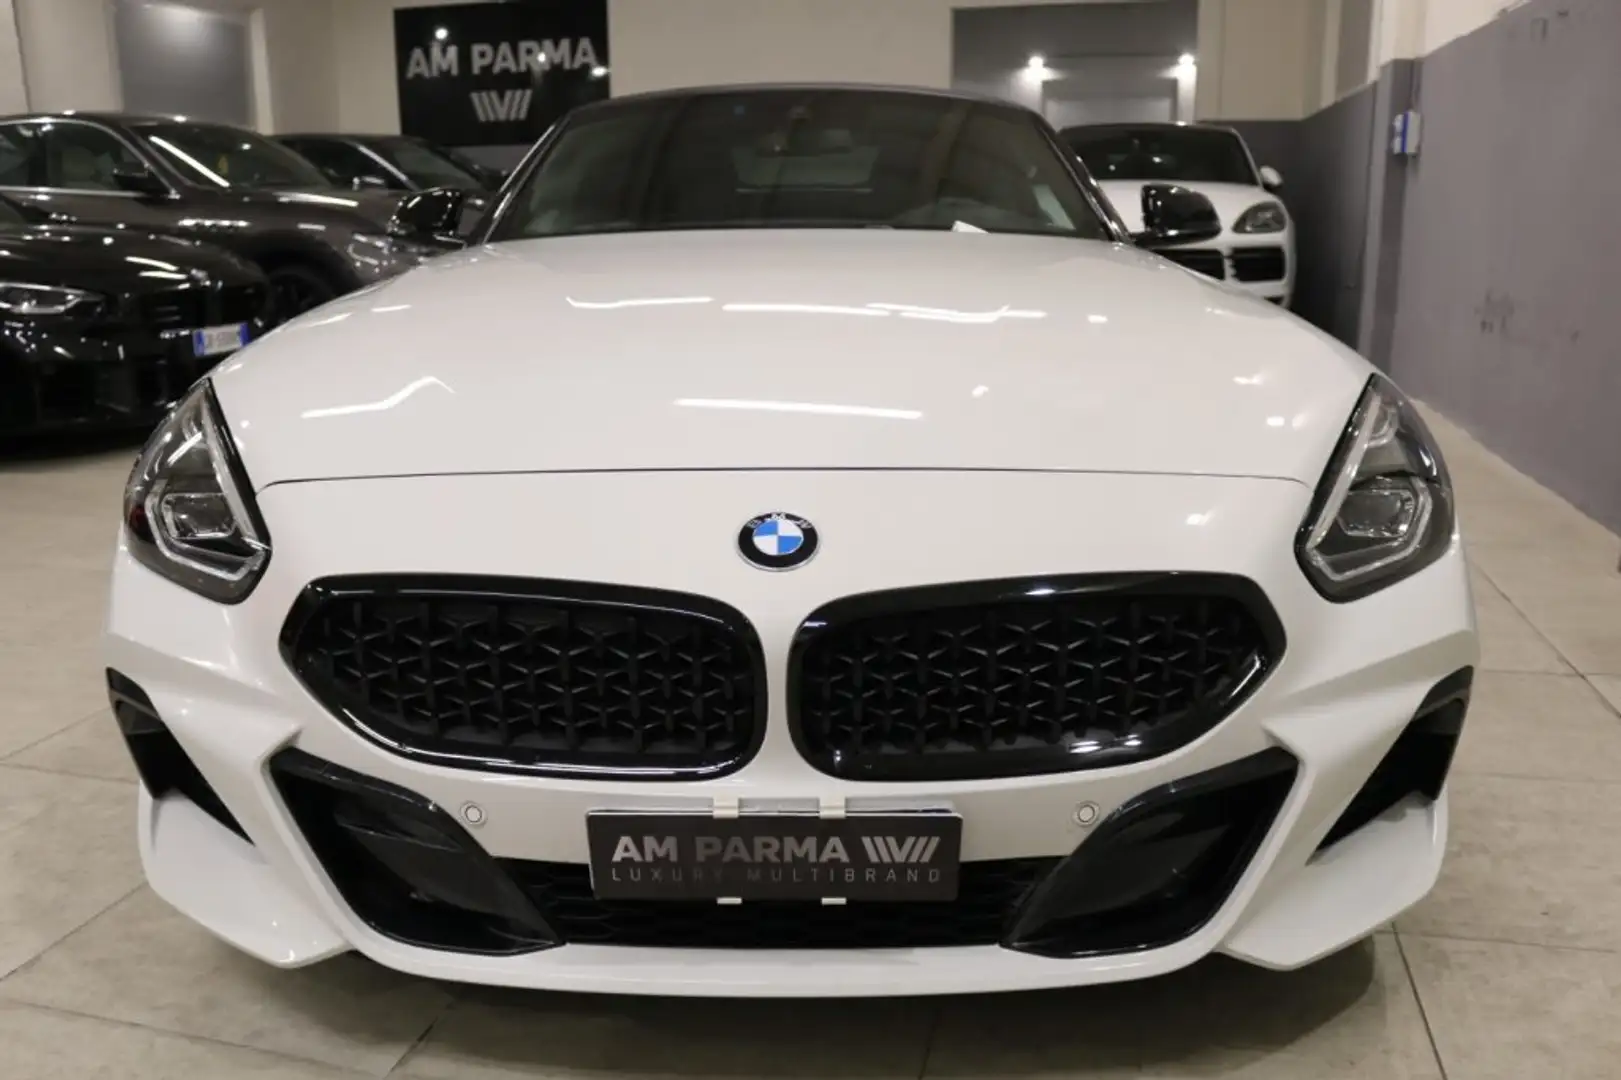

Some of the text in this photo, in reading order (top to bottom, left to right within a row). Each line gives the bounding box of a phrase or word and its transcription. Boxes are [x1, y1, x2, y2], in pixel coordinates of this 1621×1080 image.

[406, 37, 598, 78] AM PARMA
[611, 836, 850, 863] AM PARMA
[611, 868, 941, 883] LUXURY MULTIBRAND
